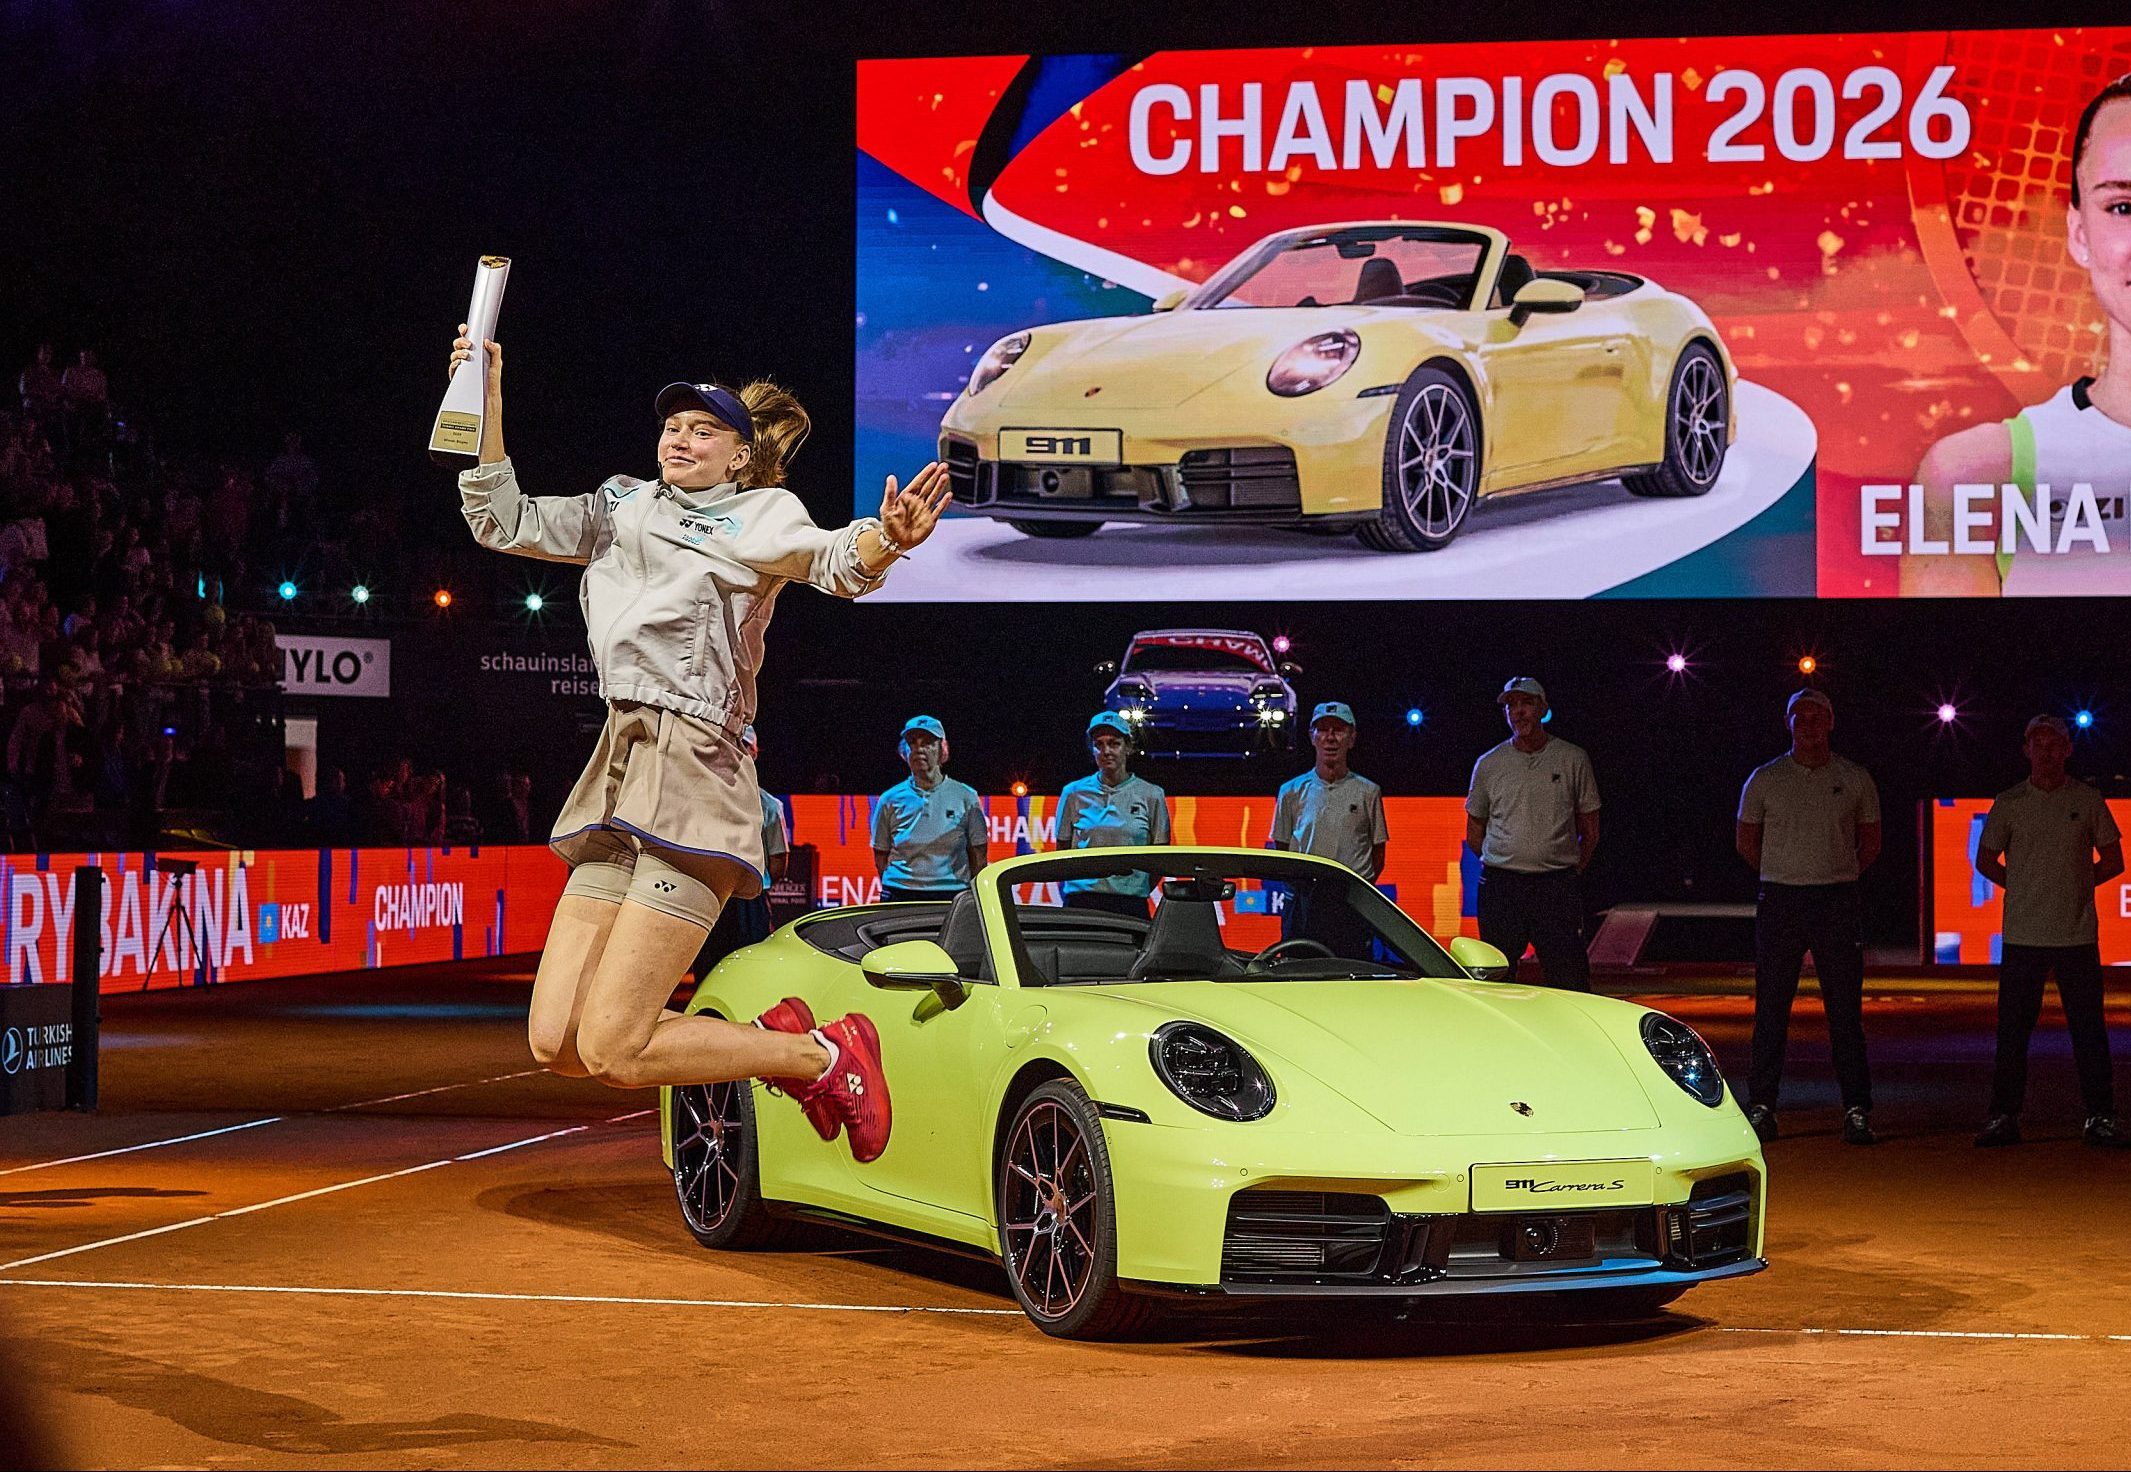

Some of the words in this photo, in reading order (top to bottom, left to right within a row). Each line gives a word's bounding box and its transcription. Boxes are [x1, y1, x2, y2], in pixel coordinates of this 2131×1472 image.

[1129, 73, 1673, 176] CHAMPION
[1706, 66, 1971, 161] 2026
[1026, 437, 1090, 455] 911
[694, 522, 714, 536] YONEX
[1861, 483, 2110, 555] ELENA
[375, 882, 463, 931] CHAMPION
[281, 904, 309, 939] KAZ
[27, 1023, 72, 1047] TURKISH
[1505, 1179, 1535, 1189] 911
[1529, 1180, 1605, 1193] Carrera
[1607, 1179, 1625, 1190] S
